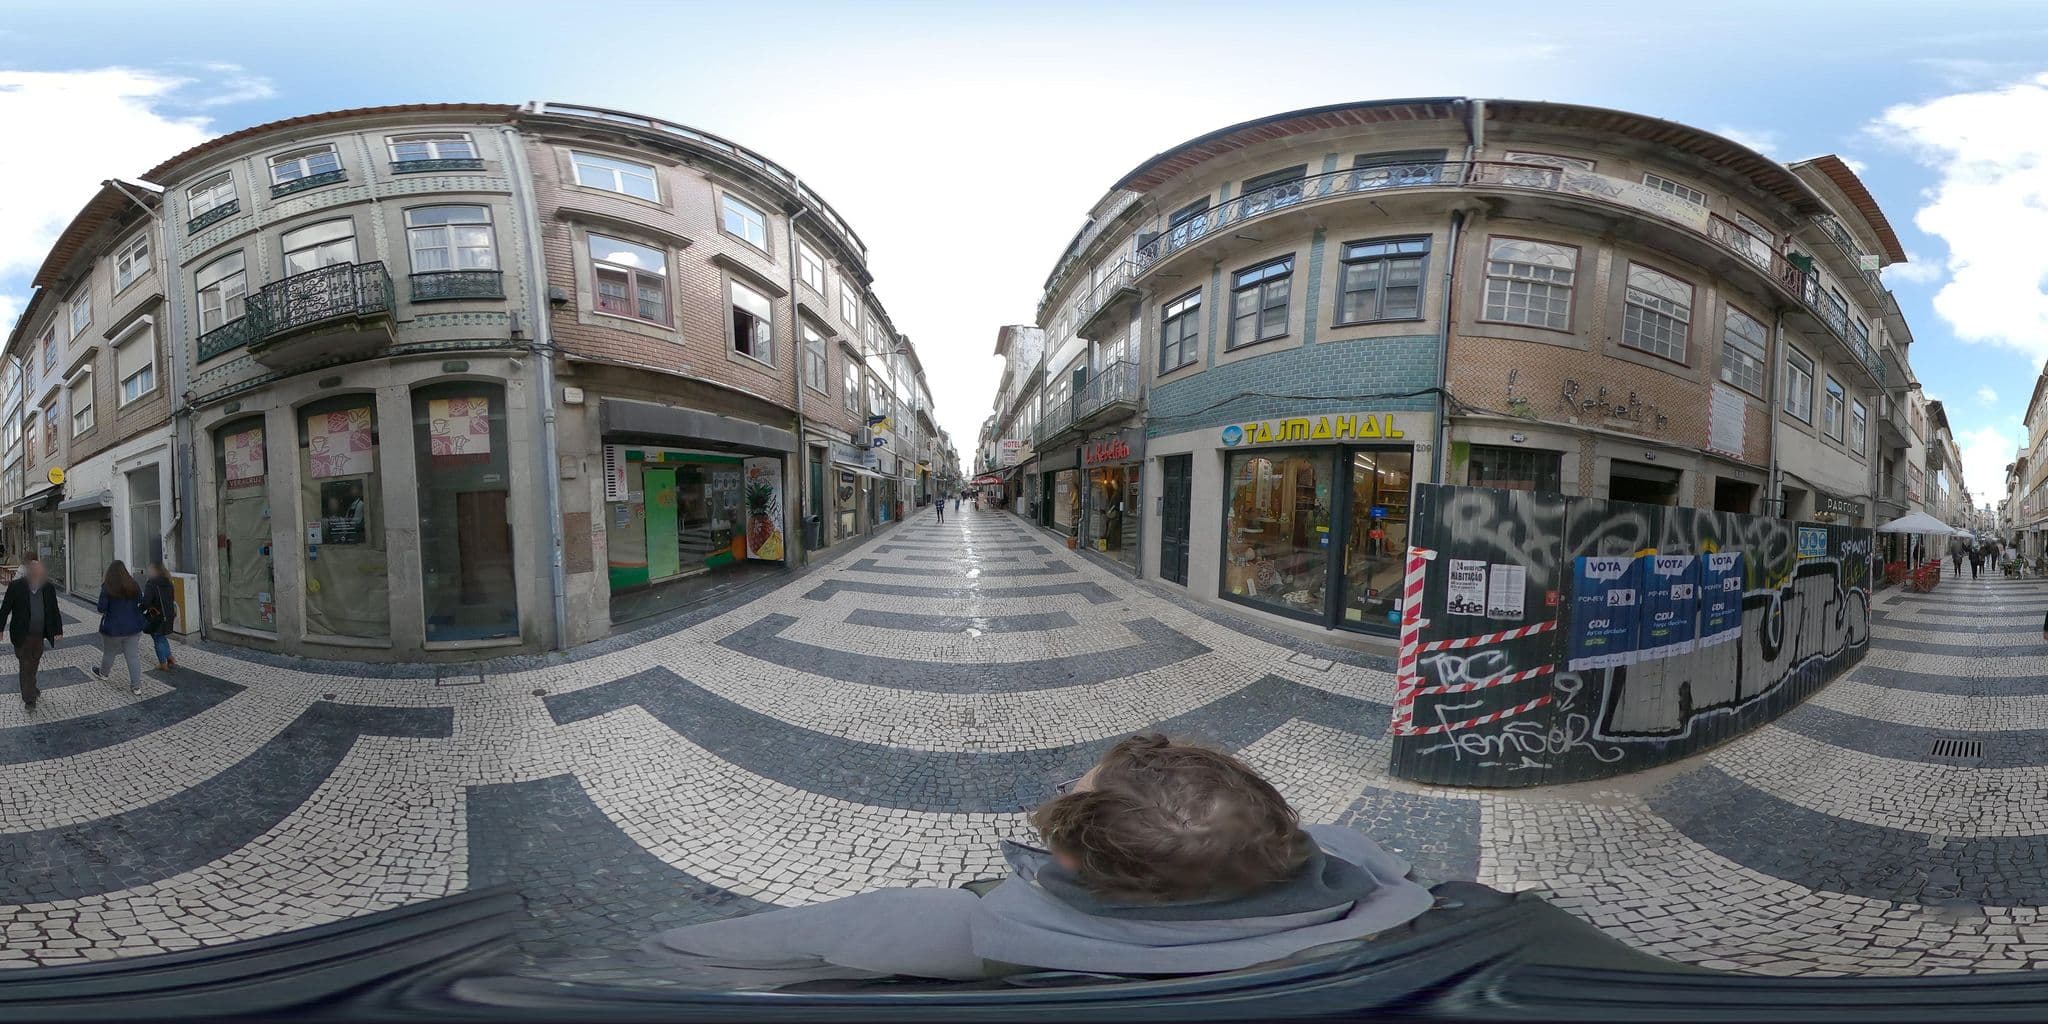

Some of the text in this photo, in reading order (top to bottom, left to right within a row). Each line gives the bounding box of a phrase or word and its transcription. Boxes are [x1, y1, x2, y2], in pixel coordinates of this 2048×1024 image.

[1244, 414, 1405, 444] TAJMAHAL
[1003, 440, 1021, 448] HOTEL
[1590, 561, 1621, 572] VOTA
[1656, 559, 1683, 569] VOTA
[1451, 571, 1483, 582] HABITAÇÃO
[1654, 611, 1674, 621] CDU
[1588, 619, 1610, 629] CDU
